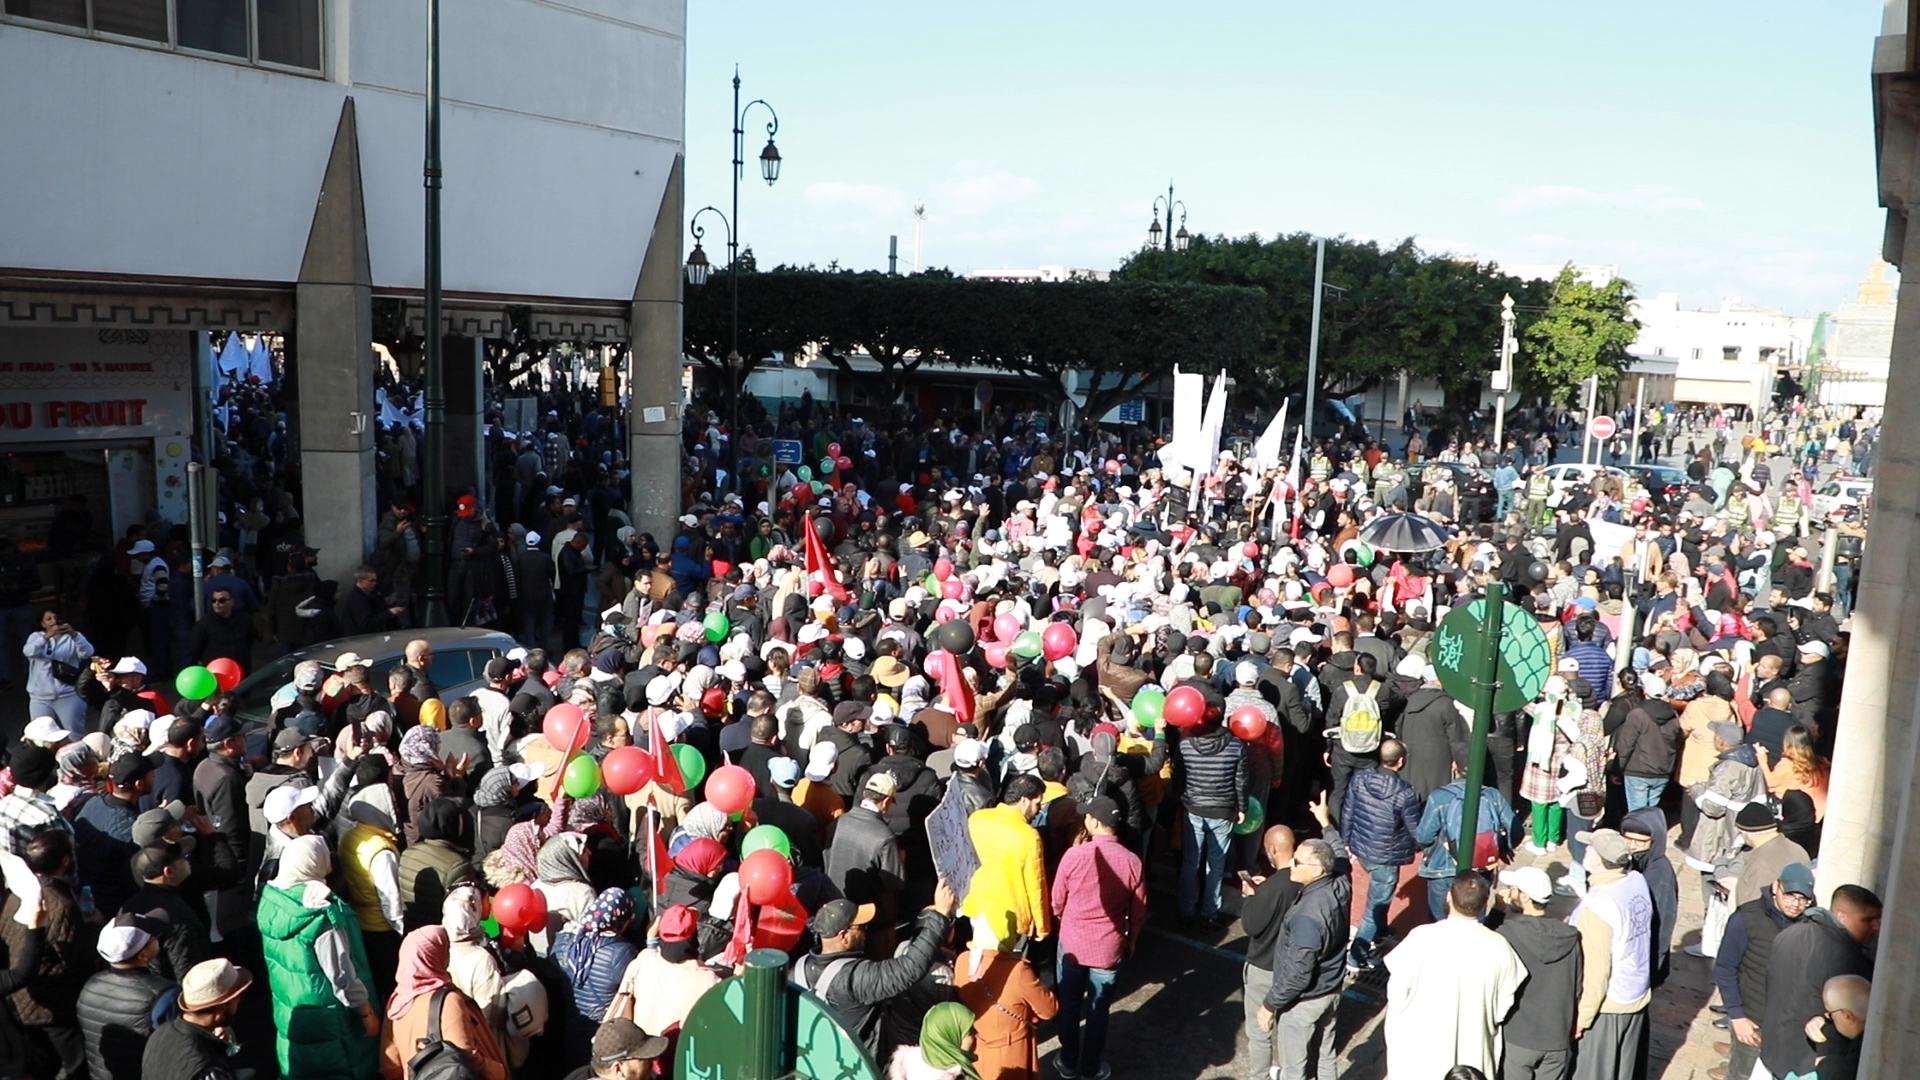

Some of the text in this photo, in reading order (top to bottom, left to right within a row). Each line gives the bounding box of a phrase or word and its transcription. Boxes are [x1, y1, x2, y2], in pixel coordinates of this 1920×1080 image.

[19, 362, 55, 372] FRAIS
[70, 362, 87, 372] 100
[104, 362, 153, 372] NATUREL
[0, 399, 147, 429] U FRUIT
